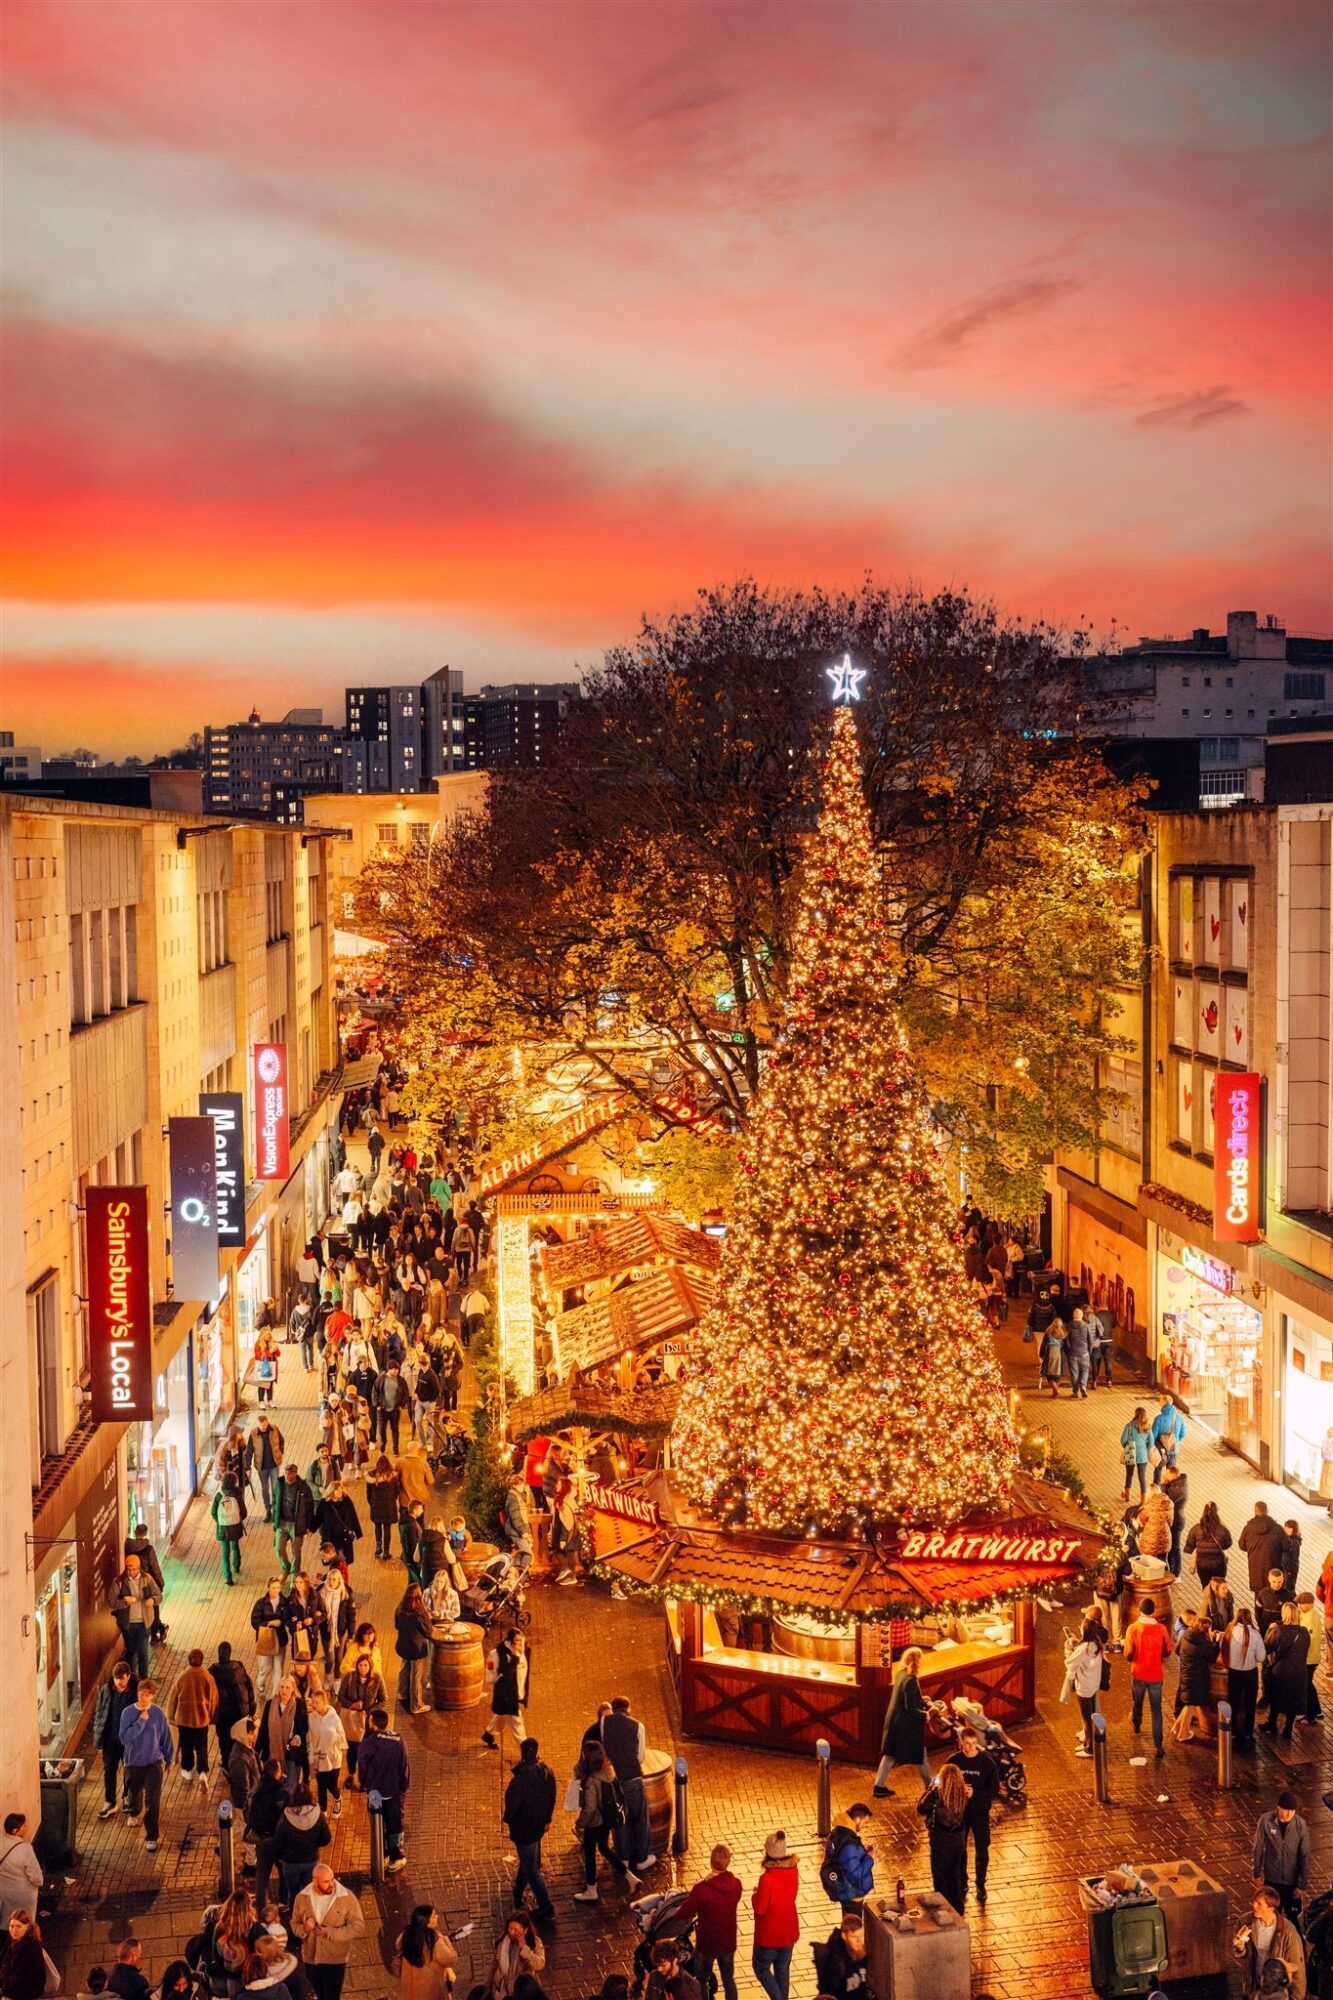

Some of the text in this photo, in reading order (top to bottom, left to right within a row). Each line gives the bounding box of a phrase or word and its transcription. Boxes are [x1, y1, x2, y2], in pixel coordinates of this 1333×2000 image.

[480, 1141, 544, 1192] ALPINE
[105, 1201, 136, 1409] Sainsbury's Local
[584, 1483, 657, 1525] BRATWURST
[902, 1535, 1082, 1562] BRATWURST
